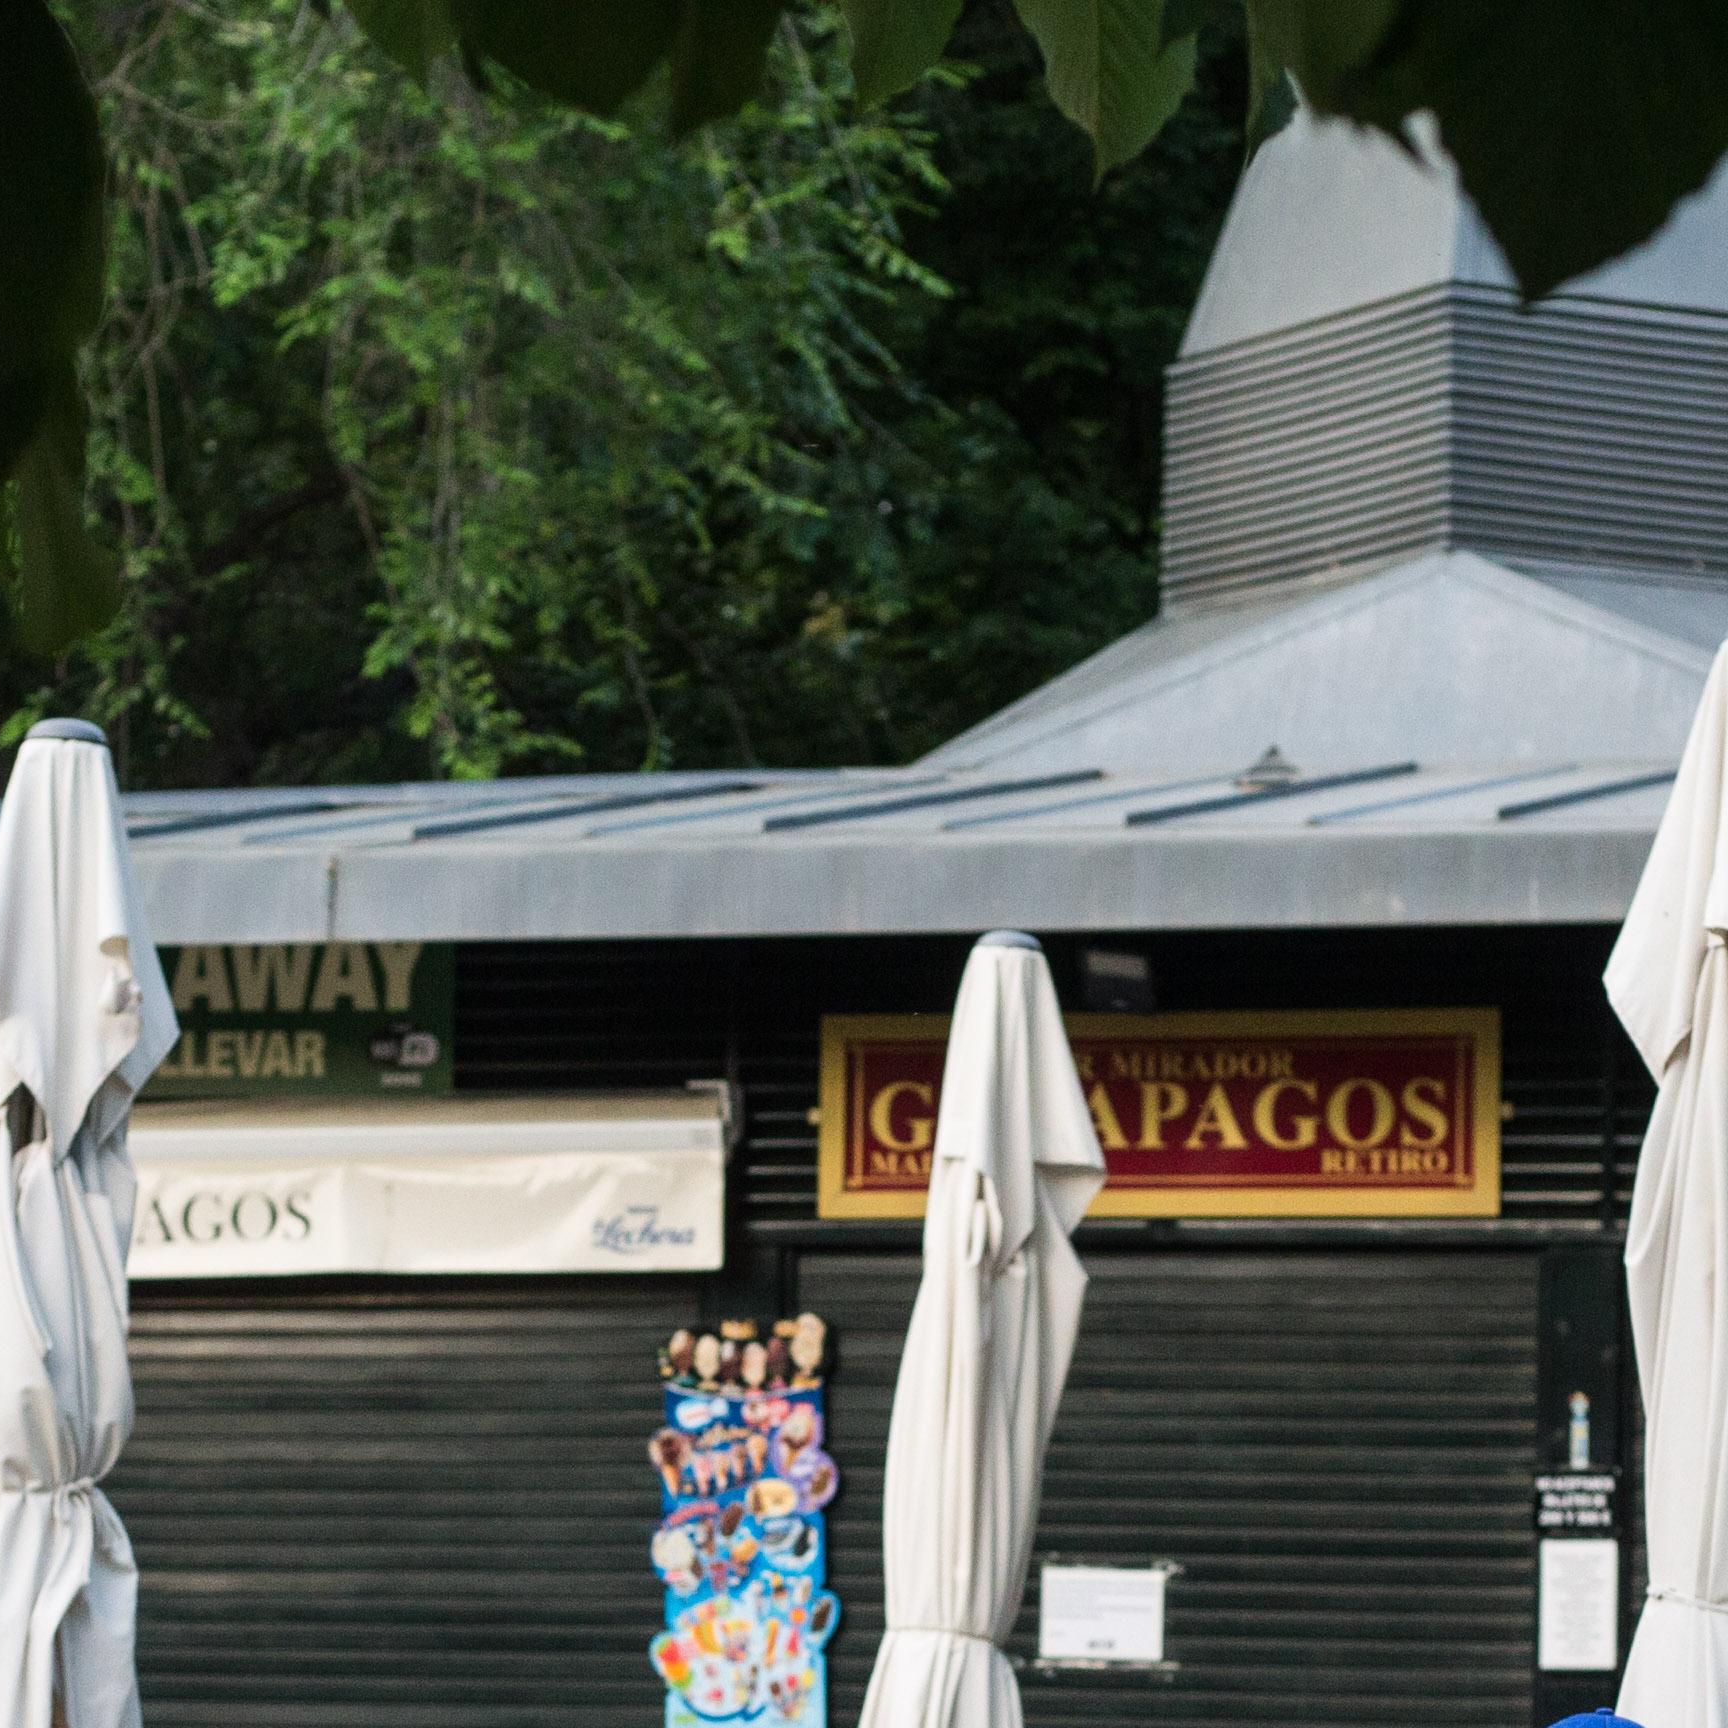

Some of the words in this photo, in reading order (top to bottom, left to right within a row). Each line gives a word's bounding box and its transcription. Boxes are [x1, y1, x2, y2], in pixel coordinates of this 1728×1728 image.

[173, 942, 421, 1011] AWAY
[1112, 1051, 1293, 1078] MIRADOR
[870, 1078, 1449, 1150] GAPAGOS
[1322, 1150, 1449, 1174] RETIRO
